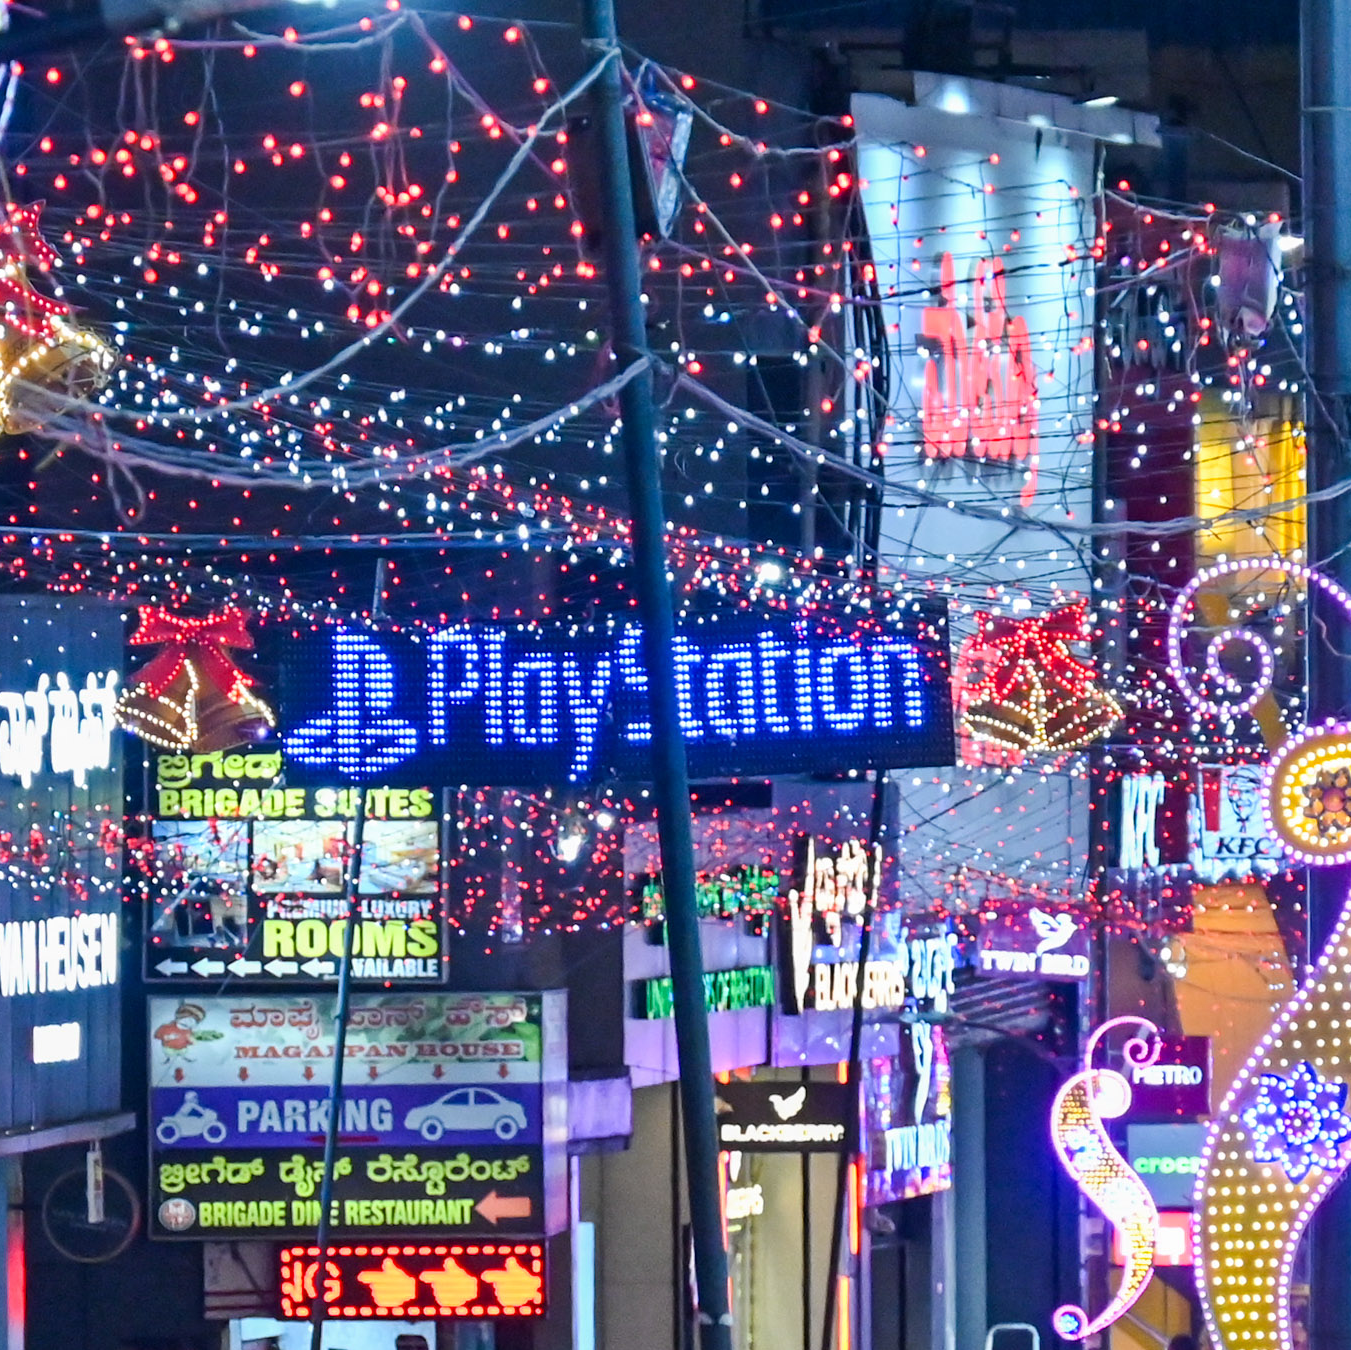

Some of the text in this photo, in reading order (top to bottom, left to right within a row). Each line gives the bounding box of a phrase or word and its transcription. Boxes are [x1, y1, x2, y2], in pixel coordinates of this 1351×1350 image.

[159, 788, 306, 817] BRIGADE
[1217, 838, 1273, 856] KFC
[263, 920, 439, 957] ROOMS
[350, 958, 440, 978] VAILABLE
[416, 1042, 522, 1057] HOUSE
[237, 1099, 394, 1133] PARKNG
[199, 1200, 287, 1227] BRIGADE
[345, 1199, 476, 1226] RESTAURANT
